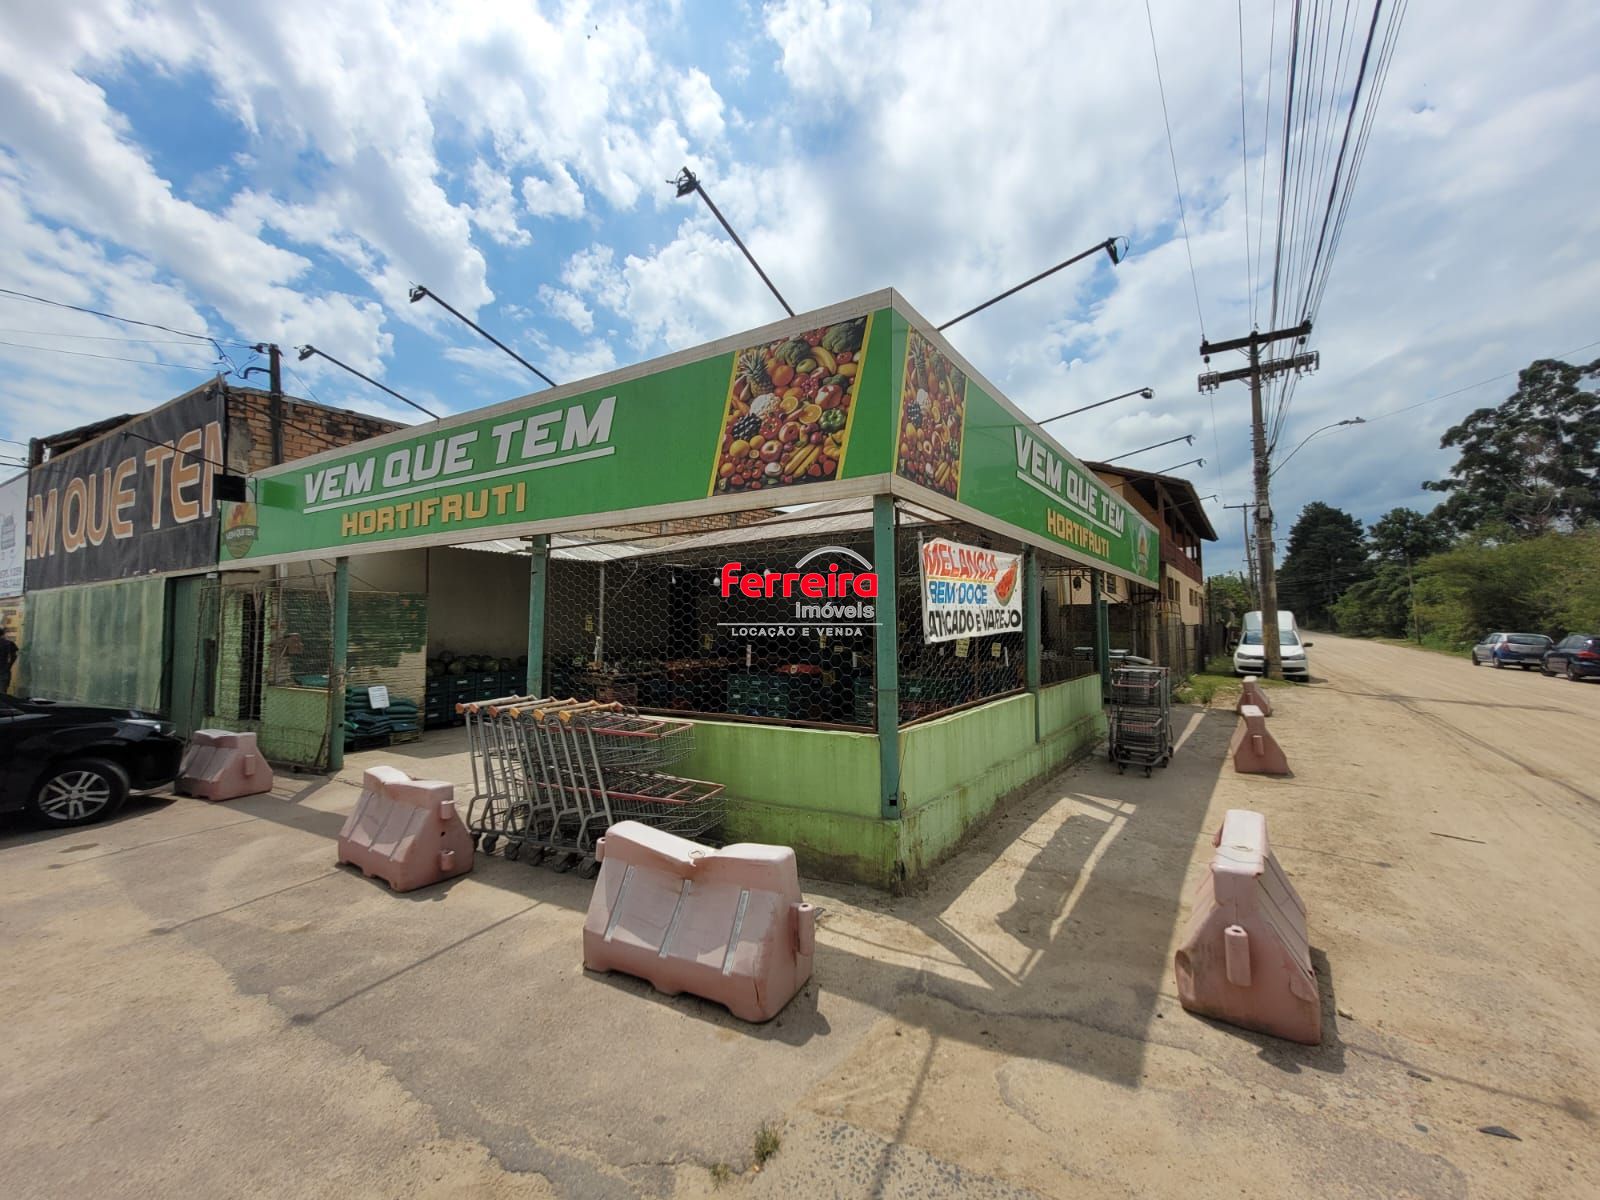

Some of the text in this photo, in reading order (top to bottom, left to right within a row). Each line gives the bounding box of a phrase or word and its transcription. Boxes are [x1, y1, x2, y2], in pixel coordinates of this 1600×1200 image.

[304, 396, 617, 504] VEM QUE TEM
[61, 456, 137, 553] QUE
[1014, 426, 1125, 532] VEM QUE TEM
[342, 482, 527, 537] HORTIFRUTI
[1047, 508, 1110, 558] HORTIFRUTI
[923, 543, 999, 581] MELANCIA
[929, 581, 988, 604] BEM DOCE
[975, 613, 981, 632] E
[981, 609, 1021, 631] VAREJO
